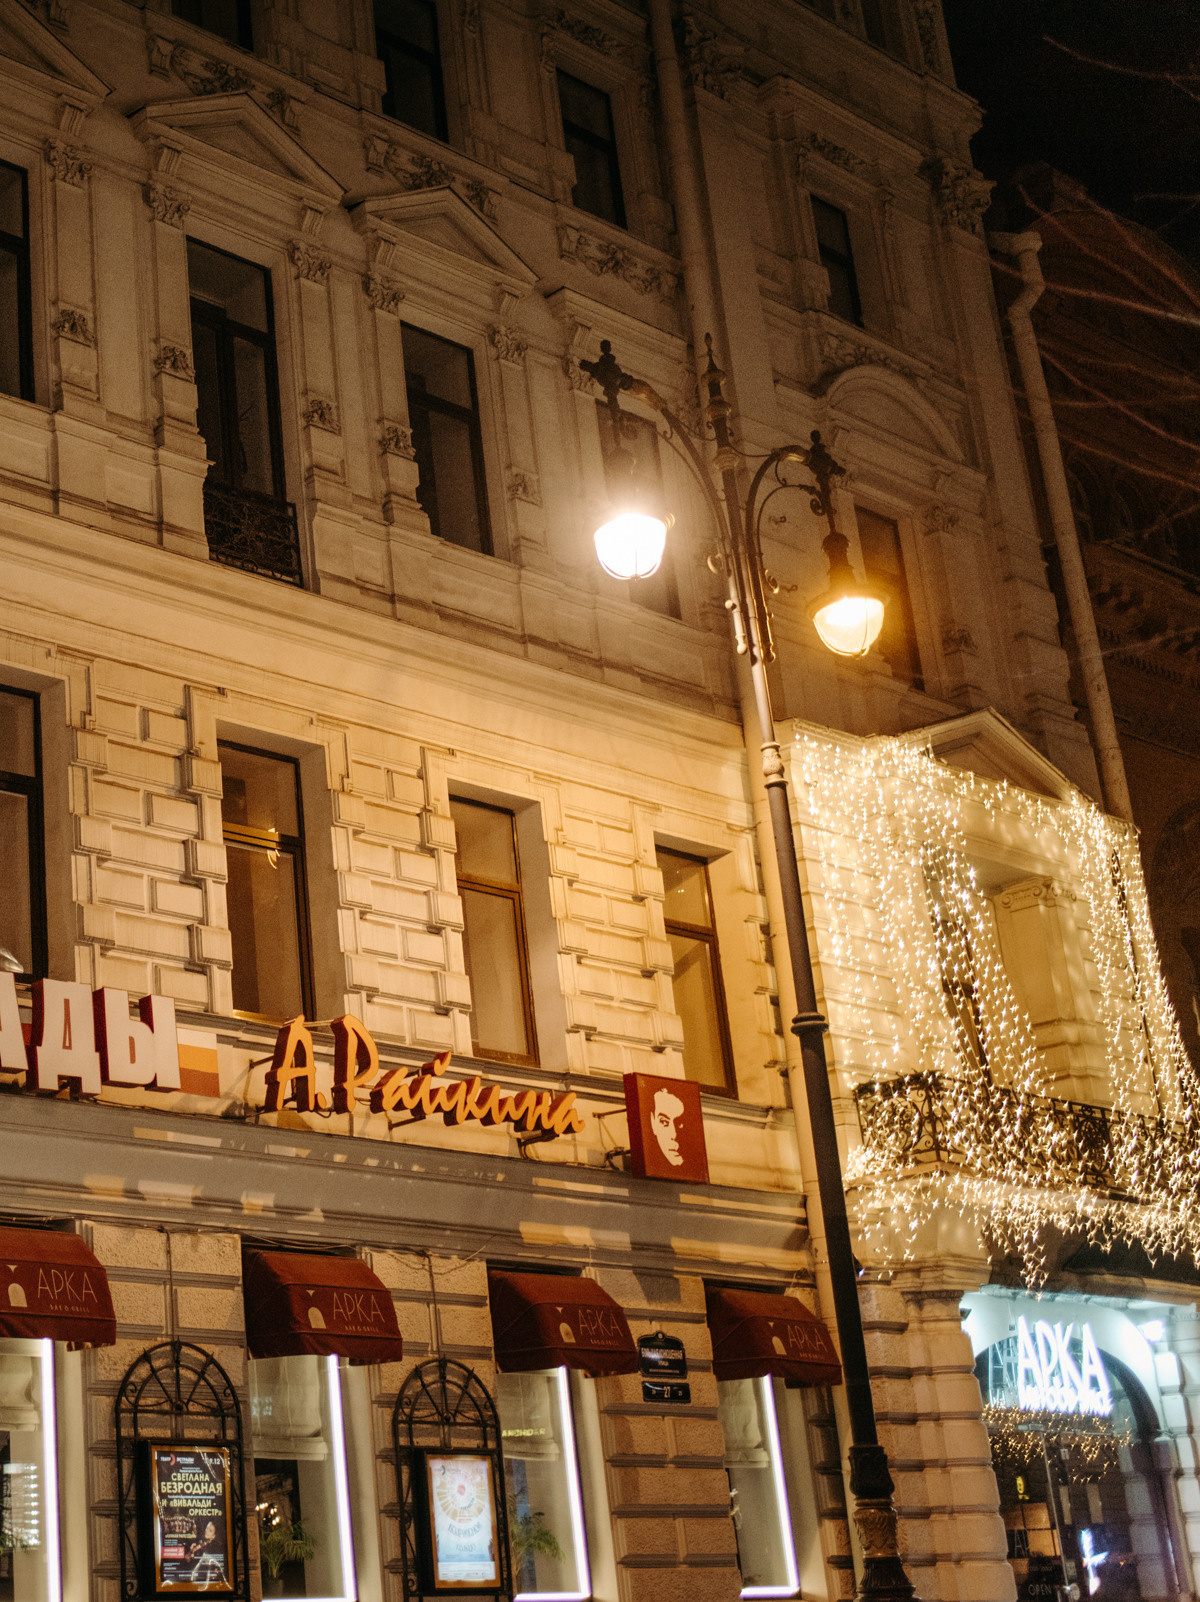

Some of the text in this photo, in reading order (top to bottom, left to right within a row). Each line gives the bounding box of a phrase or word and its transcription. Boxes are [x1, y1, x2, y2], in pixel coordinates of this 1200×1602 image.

[37, 1267, 98, 1303] АРКА
[333, 1291, 386, 1323] АРКА
[578, 1309, 623, 1337] АРКА
[787, 1324, 828, 1352] АРКА
[1018, 1314, 1111, 1398] АРКА
[160, 1481, 223, 1494] БЕЗРОДНАЯ
[171, 1472, 210, 1482] СВЕТЛАНА
